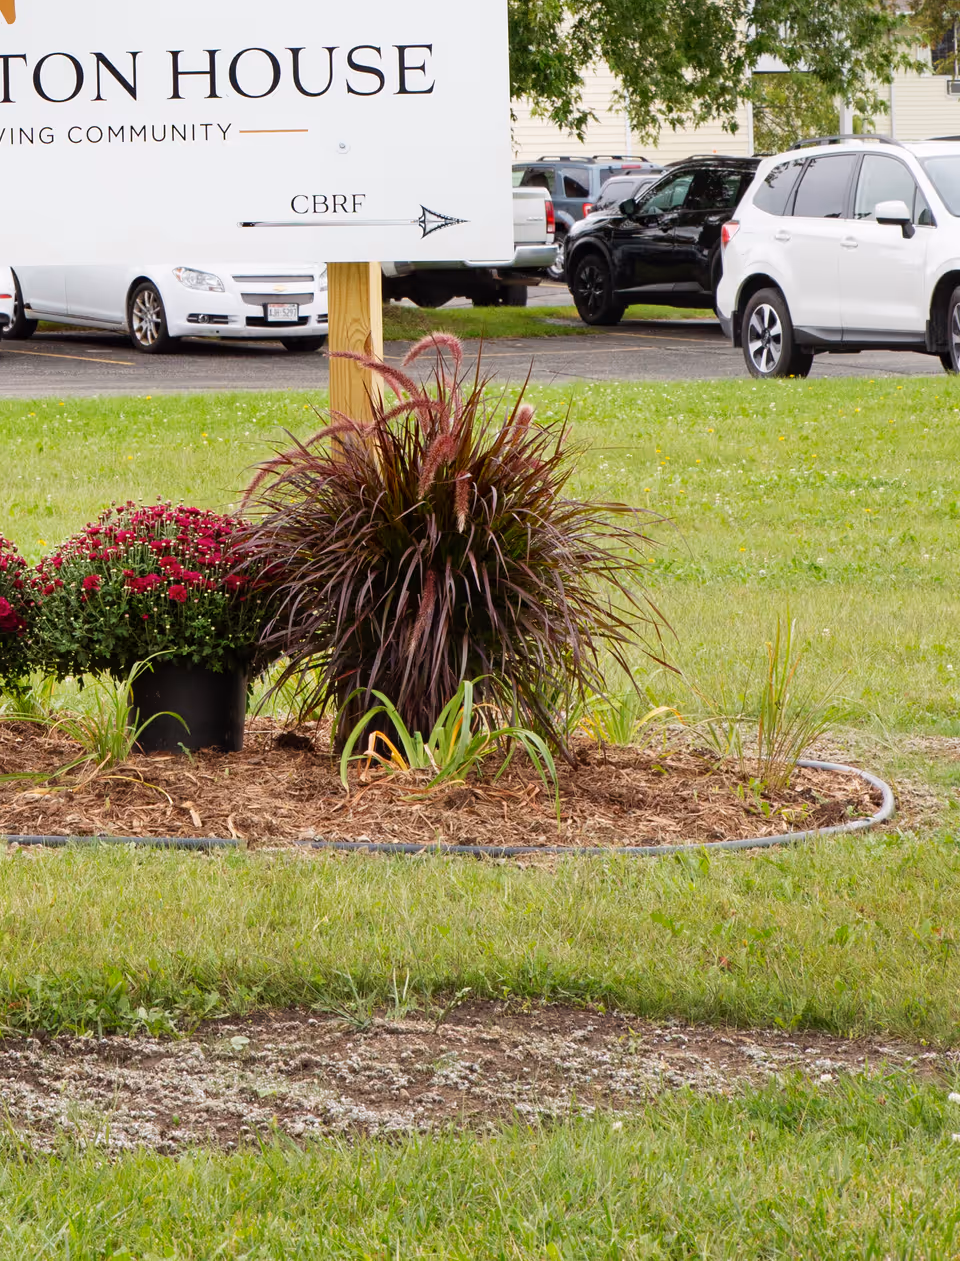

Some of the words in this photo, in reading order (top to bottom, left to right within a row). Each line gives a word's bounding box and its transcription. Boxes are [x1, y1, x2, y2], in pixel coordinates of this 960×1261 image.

[166, 43, 436, 99] HOUSE
[67, 123, 232, 144] COMMUNITY
[290, 193, 366, 214] CBRF
